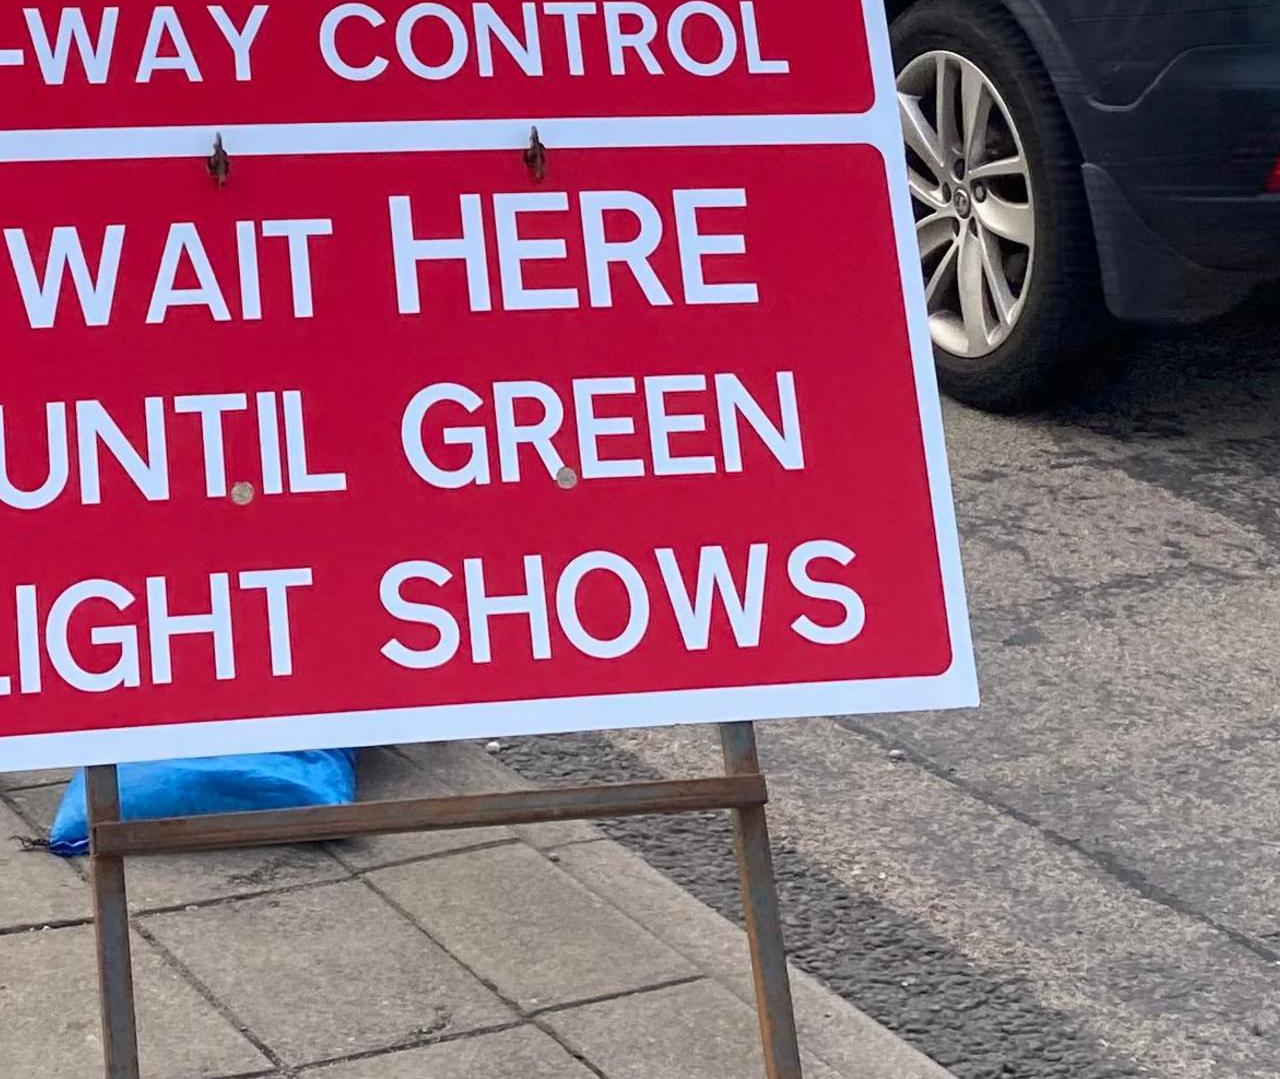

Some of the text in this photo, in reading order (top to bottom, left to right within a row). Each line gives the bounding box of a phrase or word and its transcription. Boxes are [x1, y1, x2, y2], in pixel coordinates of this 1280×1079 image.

[320, 0, 790, 81] CONTROL
[4, 188, 759, 329] WAIT HERE
[402, 372, 805, 489] GREEN
[379, 539, 866, 672] SHOWS
